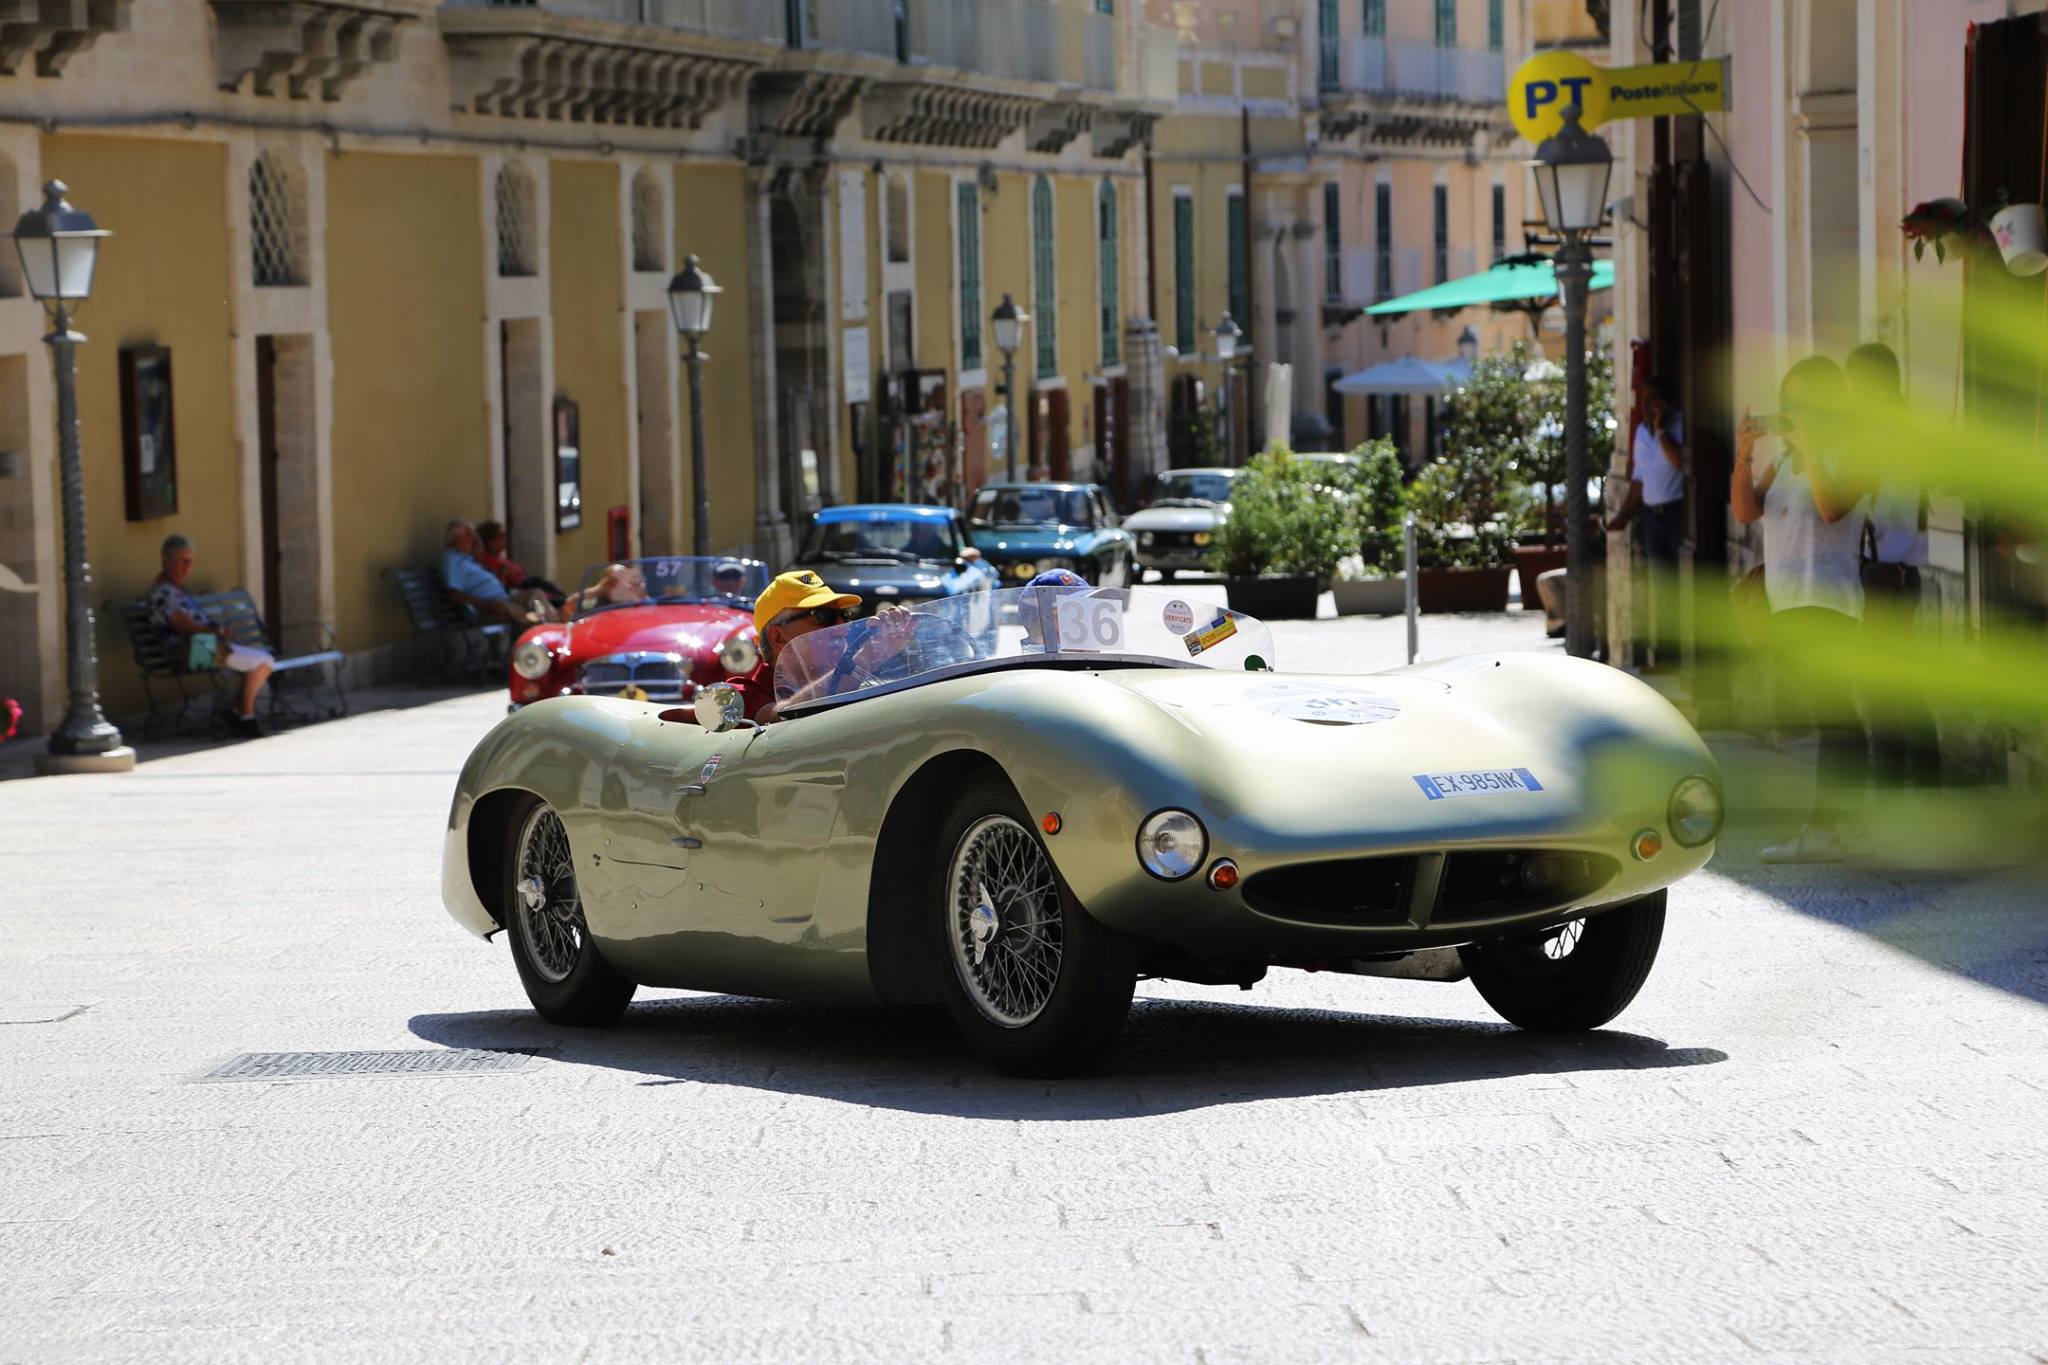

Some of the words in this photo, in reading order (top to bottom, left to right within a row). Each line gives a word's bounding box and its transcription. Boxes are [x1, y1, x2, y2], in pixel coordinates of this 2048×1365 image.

[1526, 77, 1592, 118] PT
[656, 560, 682, 577] 57
[1060, 601, 1120, 646] 36
